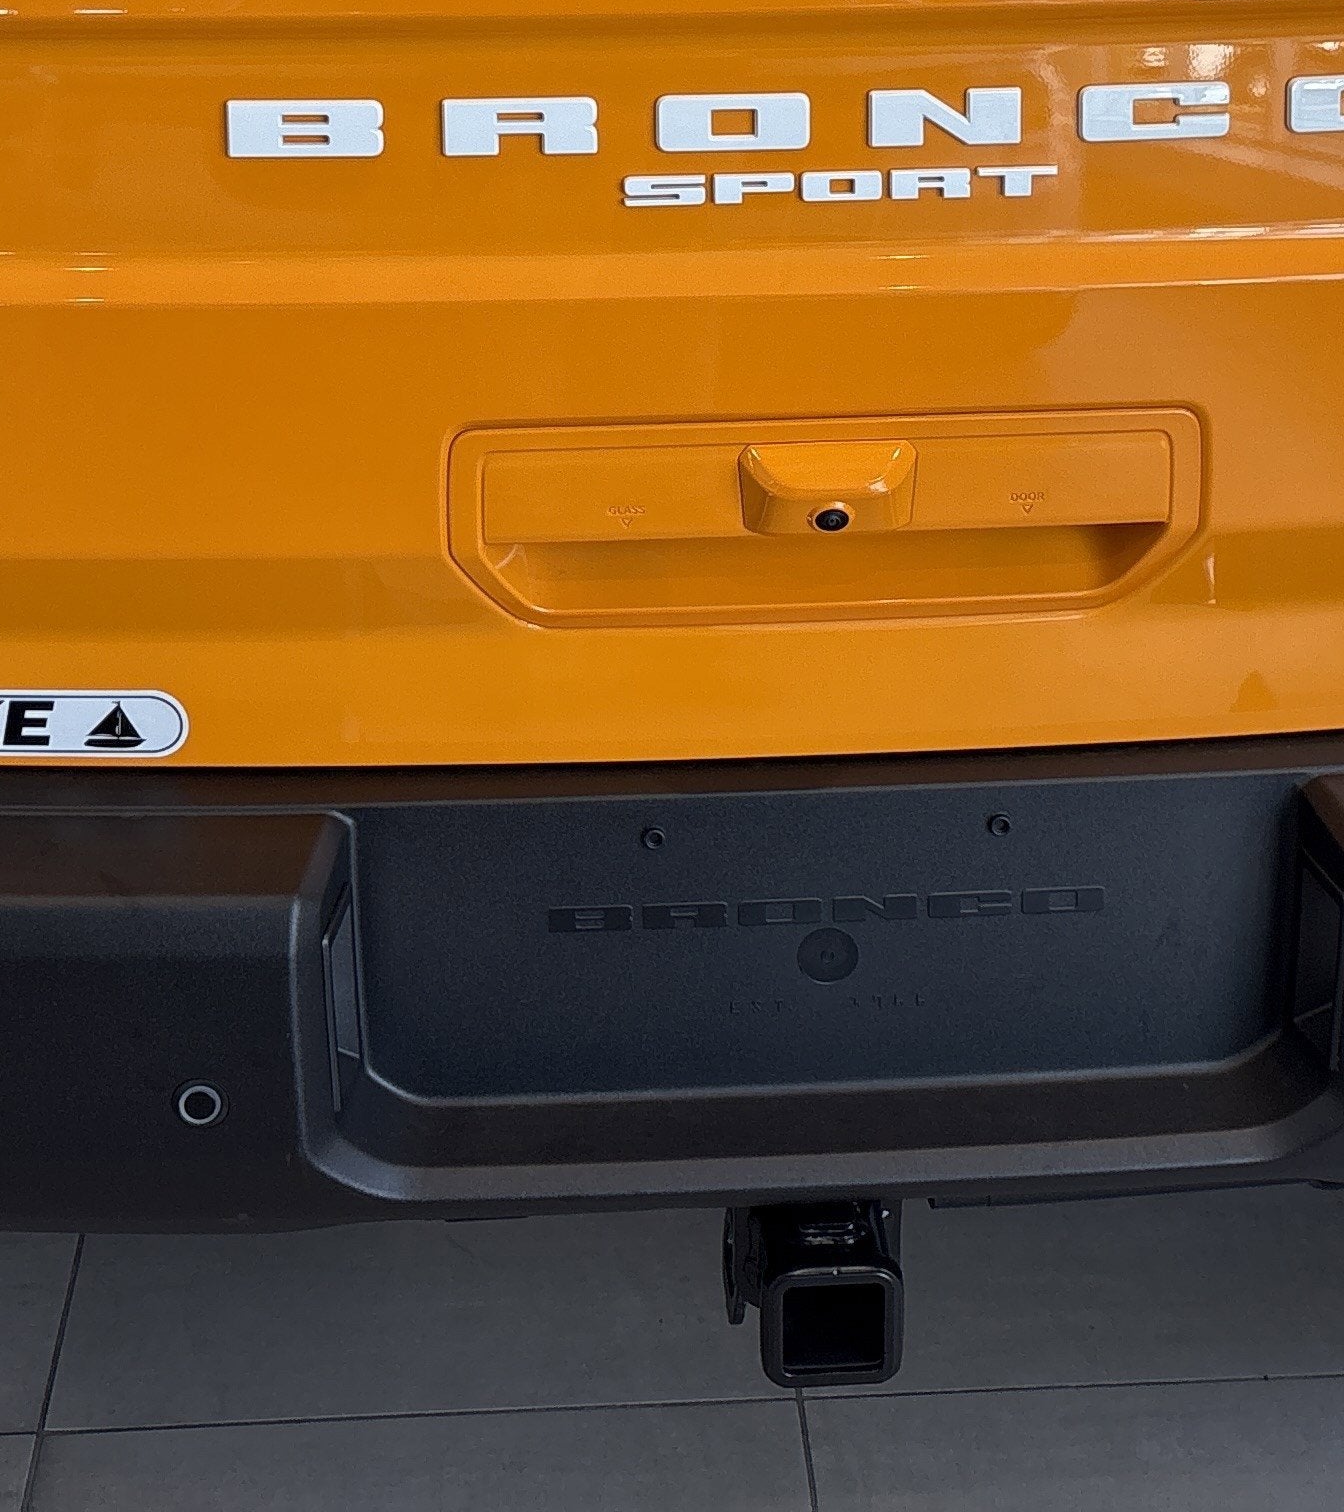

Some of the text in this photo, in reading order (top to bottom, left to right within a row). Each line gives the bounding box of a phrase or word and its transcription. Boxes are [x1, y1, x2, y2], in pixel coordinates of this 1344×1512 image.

[622, 165, 1058, 207] SPORT
[1010, 491, 1045, 502] DOOR
[608, 505, 646, 515] GLASS
[548, 886, 1105, 932] BRONCO
